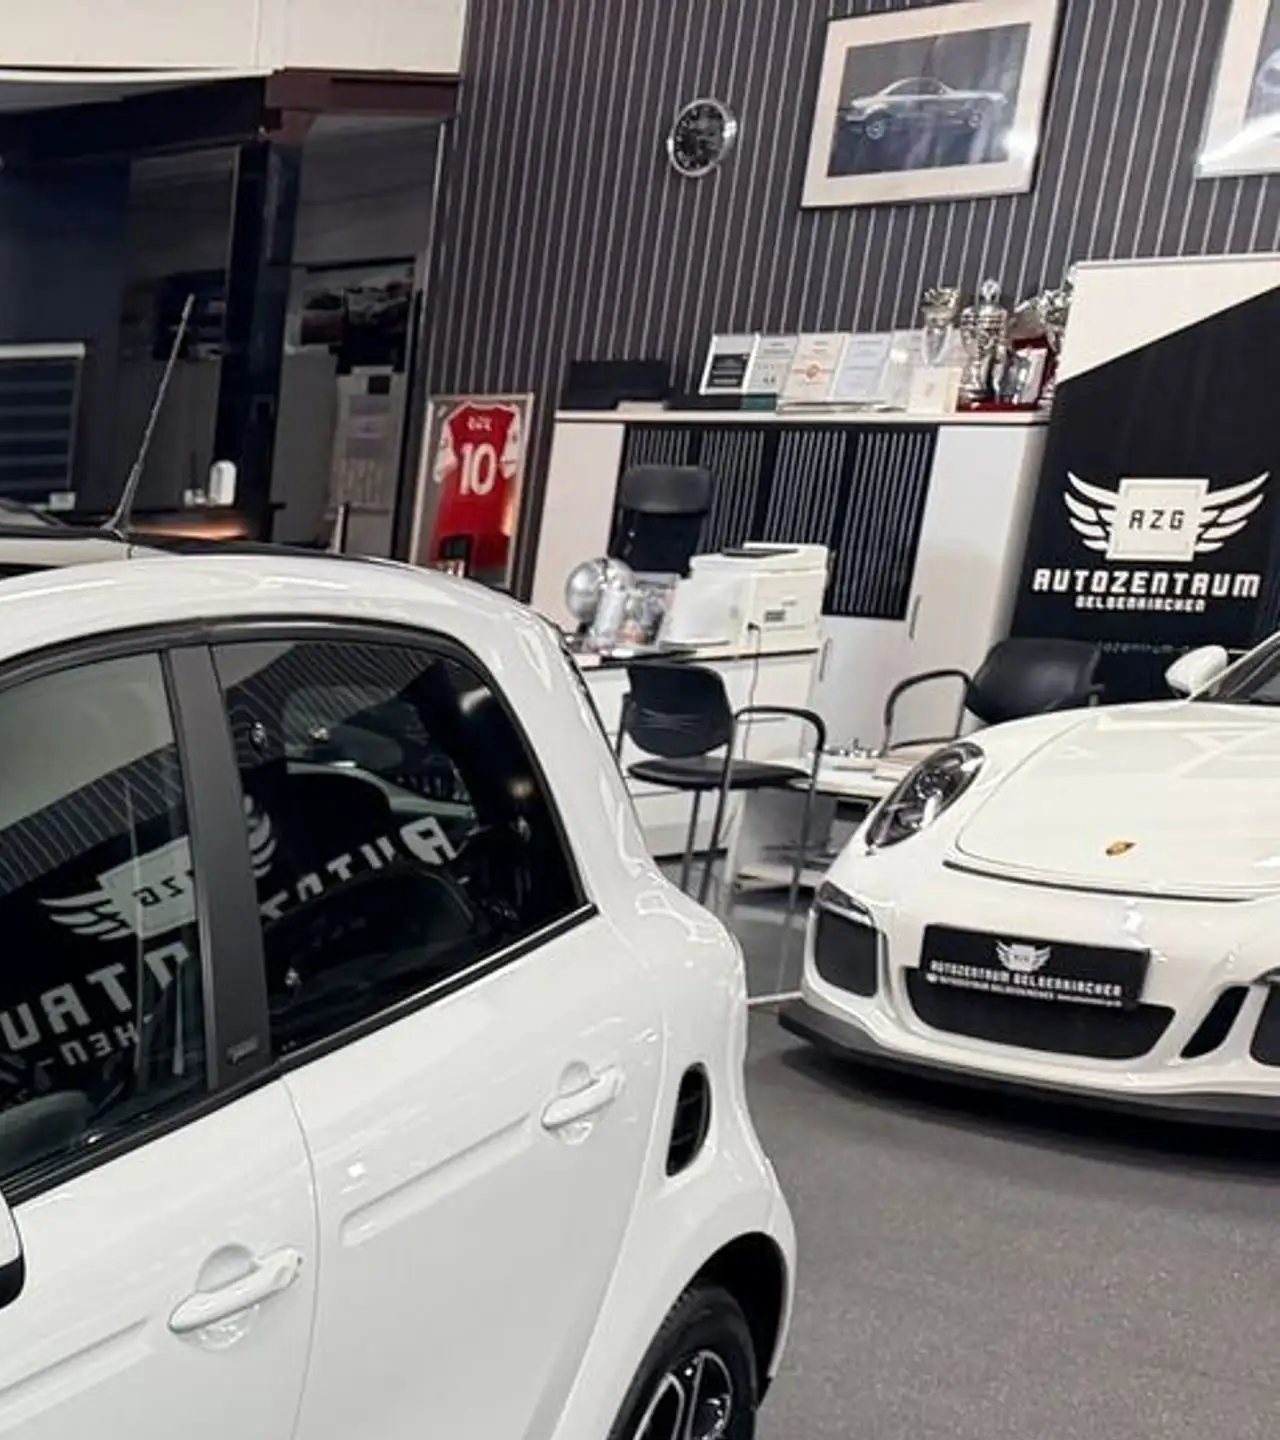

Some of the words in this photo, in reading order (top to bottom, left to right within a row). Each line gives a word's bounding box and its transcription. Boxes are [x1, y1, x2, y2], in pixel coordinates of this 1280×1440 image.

[460, 443, 496, 495] 10
[1129, 509, 1185, 530] AZG
[1032, 568, 1261, 598] AUTOZENTRUM
[929, 959, 1010, 983] AUTOZENTRUM
